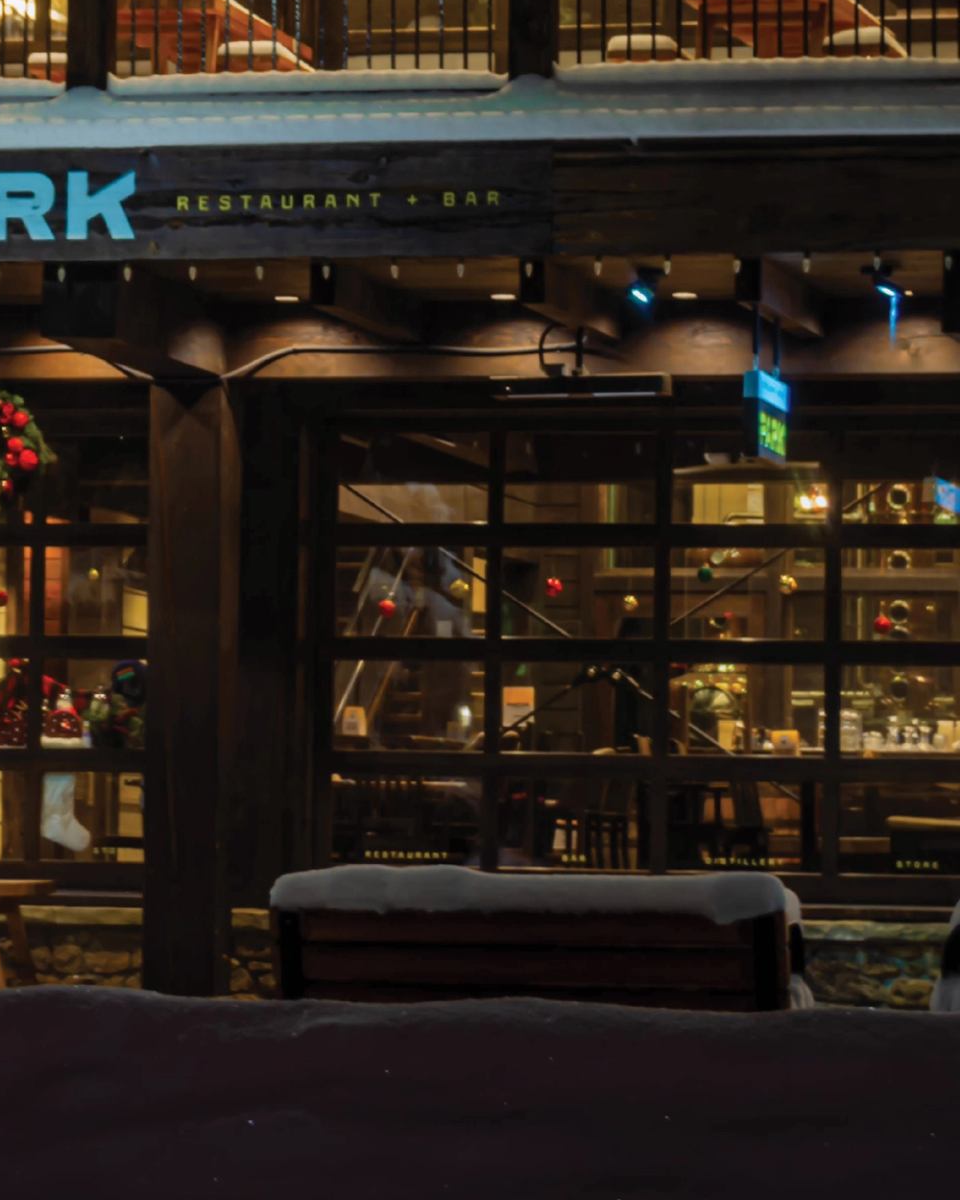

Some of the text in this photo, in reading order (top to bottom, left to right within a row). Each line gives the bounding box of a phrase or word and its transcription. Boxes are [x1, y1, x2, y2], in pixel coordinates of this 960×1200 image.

[176, 192, 382, 212] RESTAURANT
[443, 190, 501, 208] BAR
[364, 850, 449, 860] RESTAURANT
